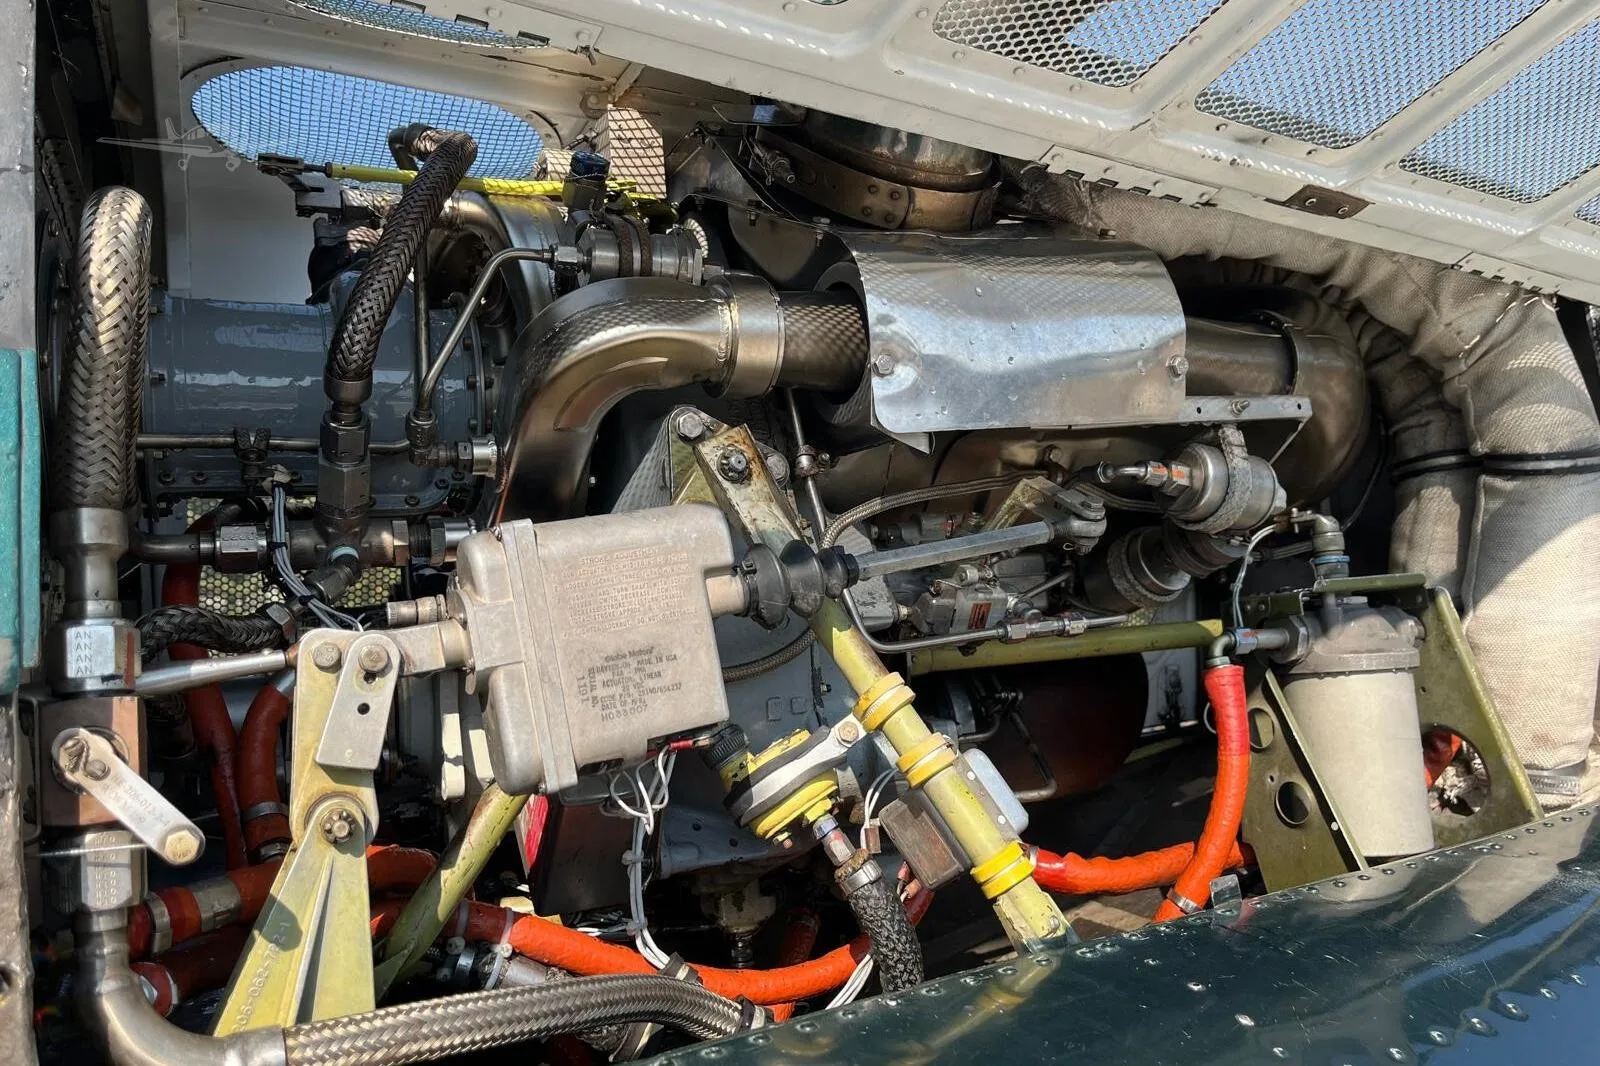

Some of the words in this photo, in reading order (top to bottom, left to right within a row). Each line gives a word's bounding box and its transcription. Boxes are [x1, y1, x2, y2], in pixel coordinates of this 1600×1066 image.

[75, 631, 92, 640] AN
[75, 643, 92, 652] AN
[76, 654, 92, 663] AN
[76, 666, 92, 675] AN
